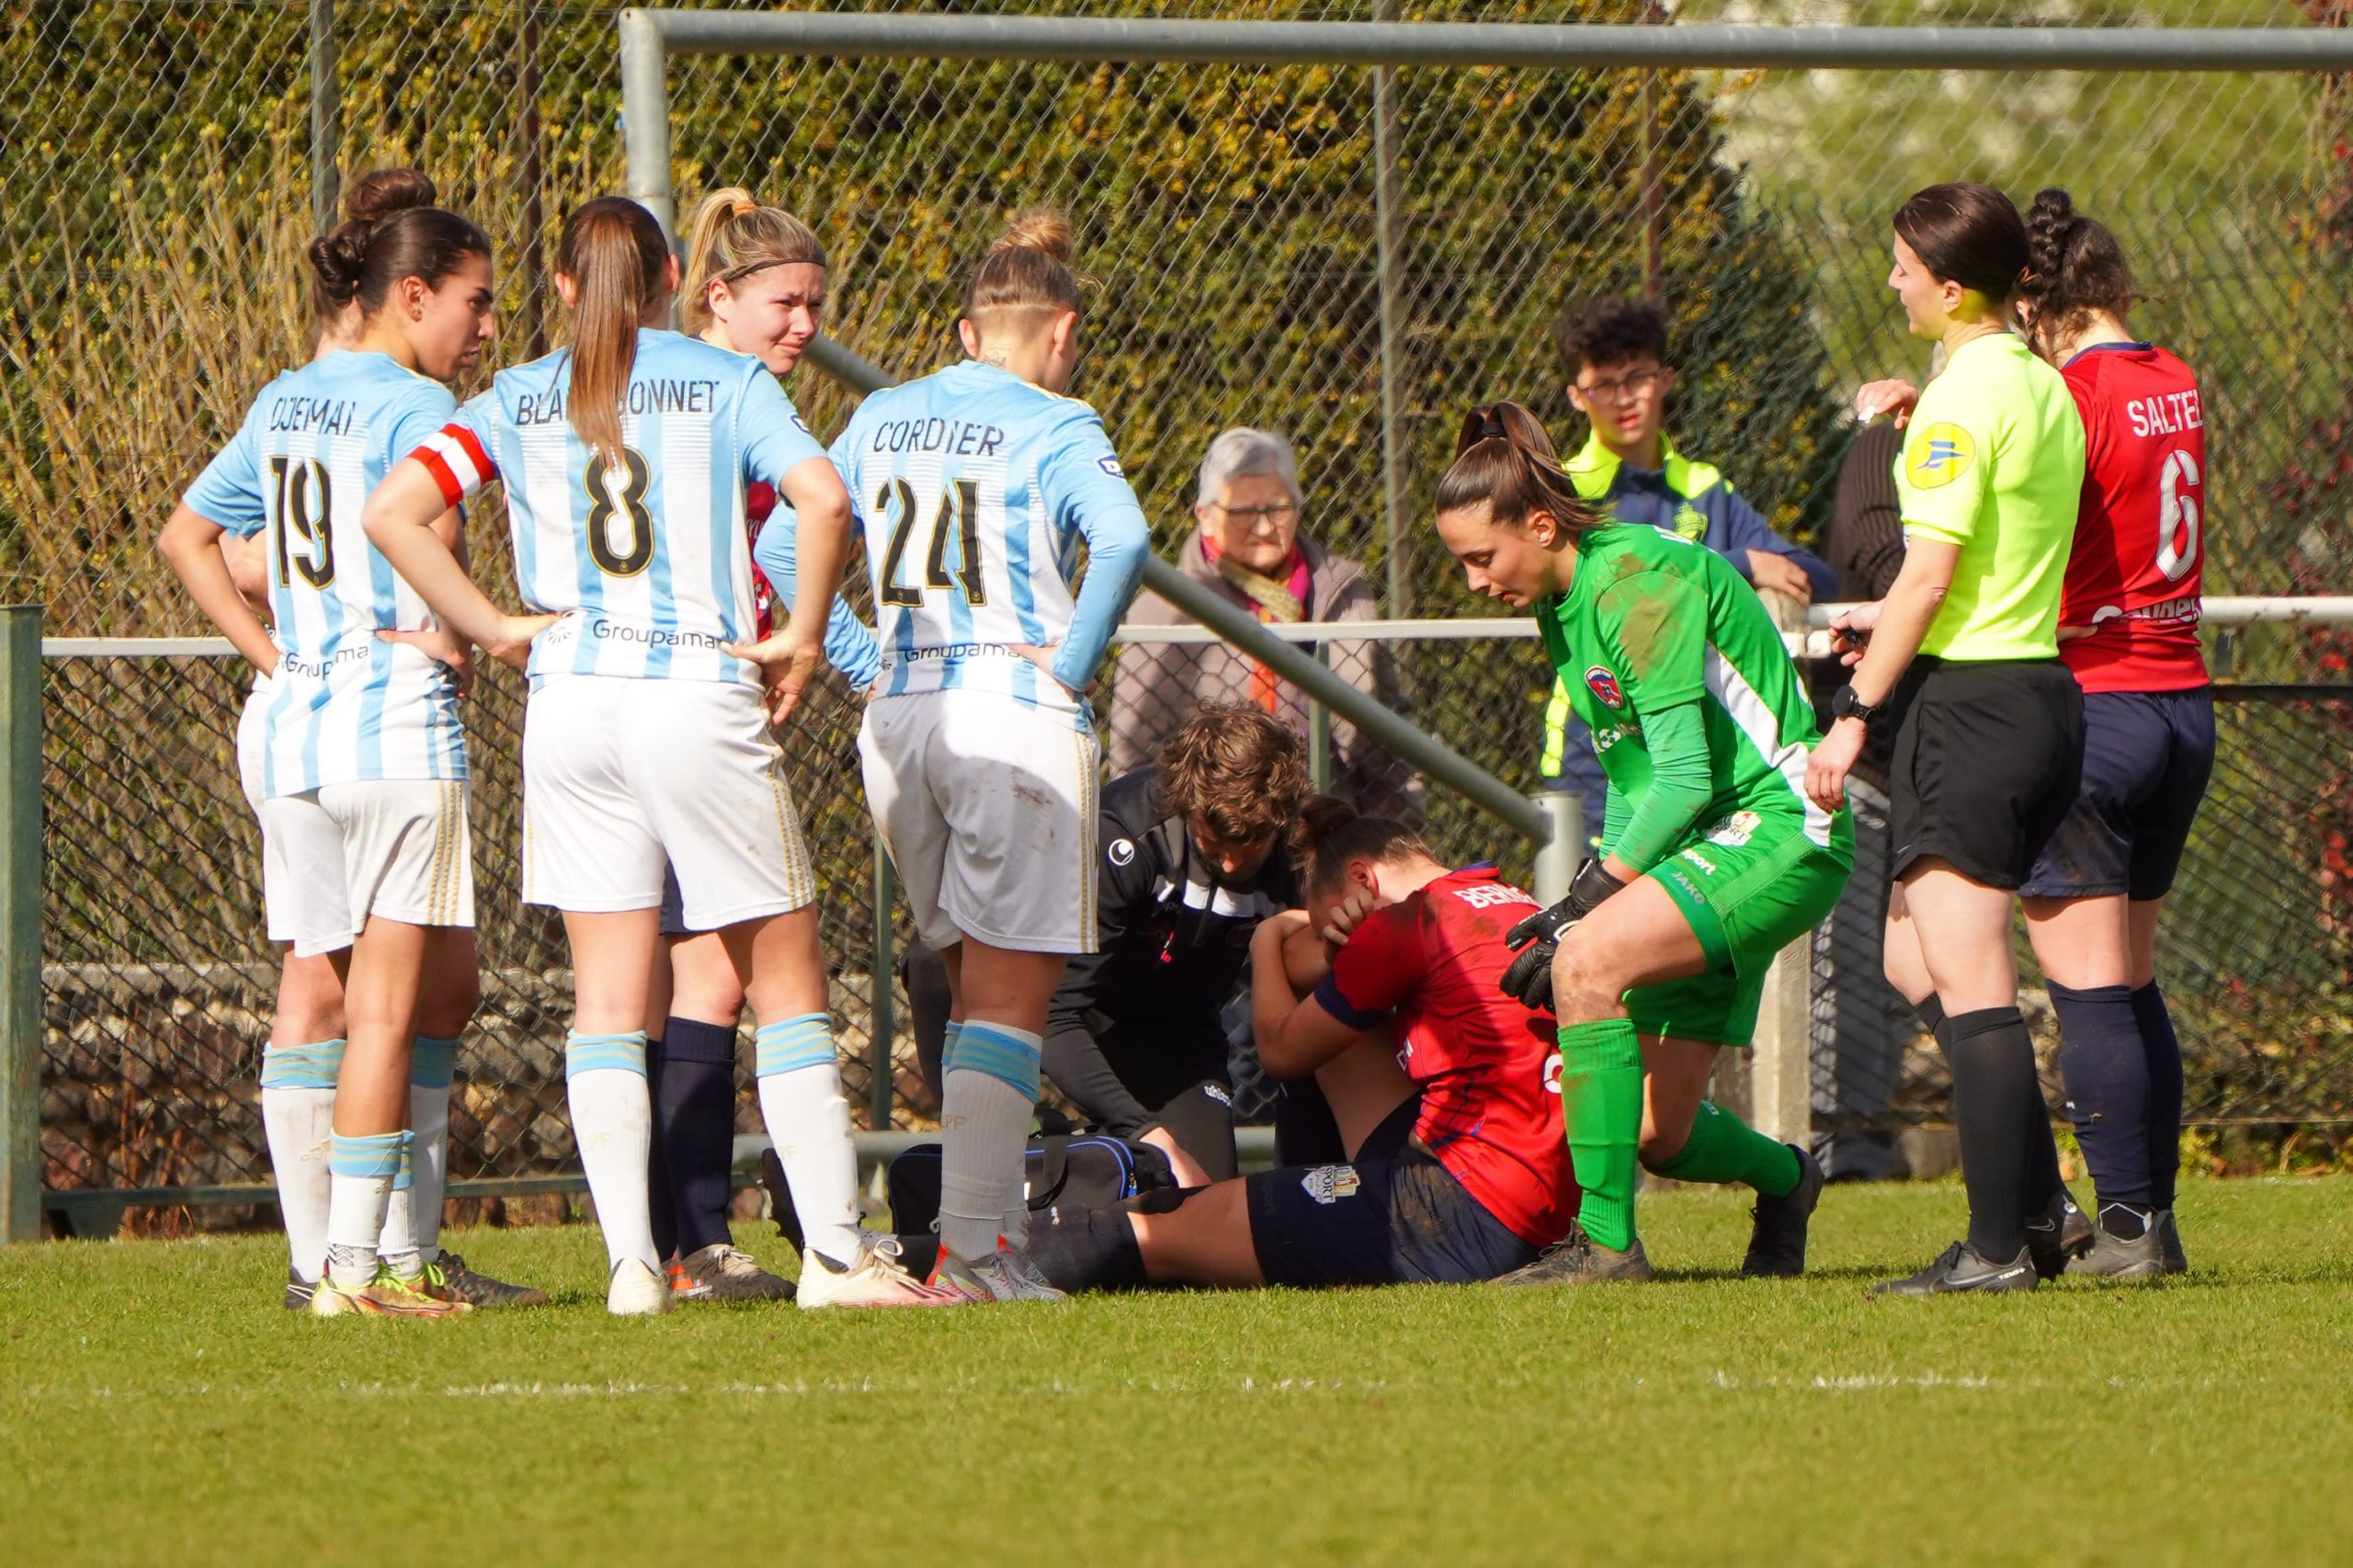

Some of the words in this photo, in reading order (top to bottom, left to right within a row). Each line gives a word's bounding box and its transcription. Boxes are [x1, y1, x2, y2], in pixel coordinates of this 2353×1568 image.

[270, 397, 356, 437] DJEMAI
[516, 379, 721, 426] BLAONNET
[874, 417, 1004, 456] CORDIER
[269, 455, 335, 590] 19
[584, 445, 655, 578] 8
[2156, 449, 2200, 582] 6
[875, 475, 987, 607] 24
[593, 619, 719, 649] Groupama
[1671, 871, 1707, 905] JAKO
